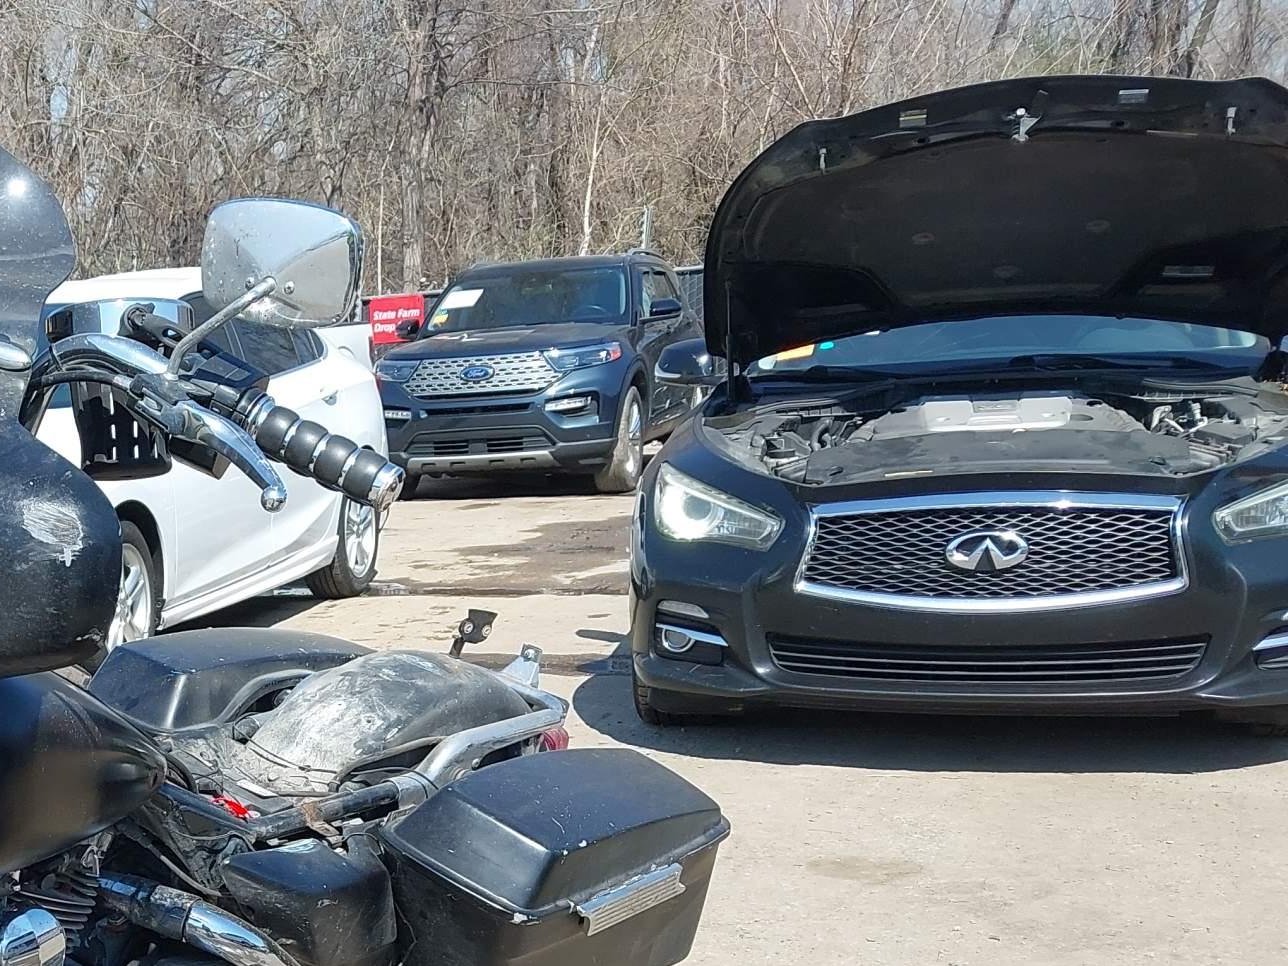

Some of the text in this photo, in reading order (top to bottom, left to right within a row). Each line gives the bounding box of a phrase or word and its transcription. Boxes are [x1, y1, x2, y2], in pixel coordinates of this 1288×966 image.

[373, 308, 420, 320] State Farm
[374, 323, 396, 333] Drop
